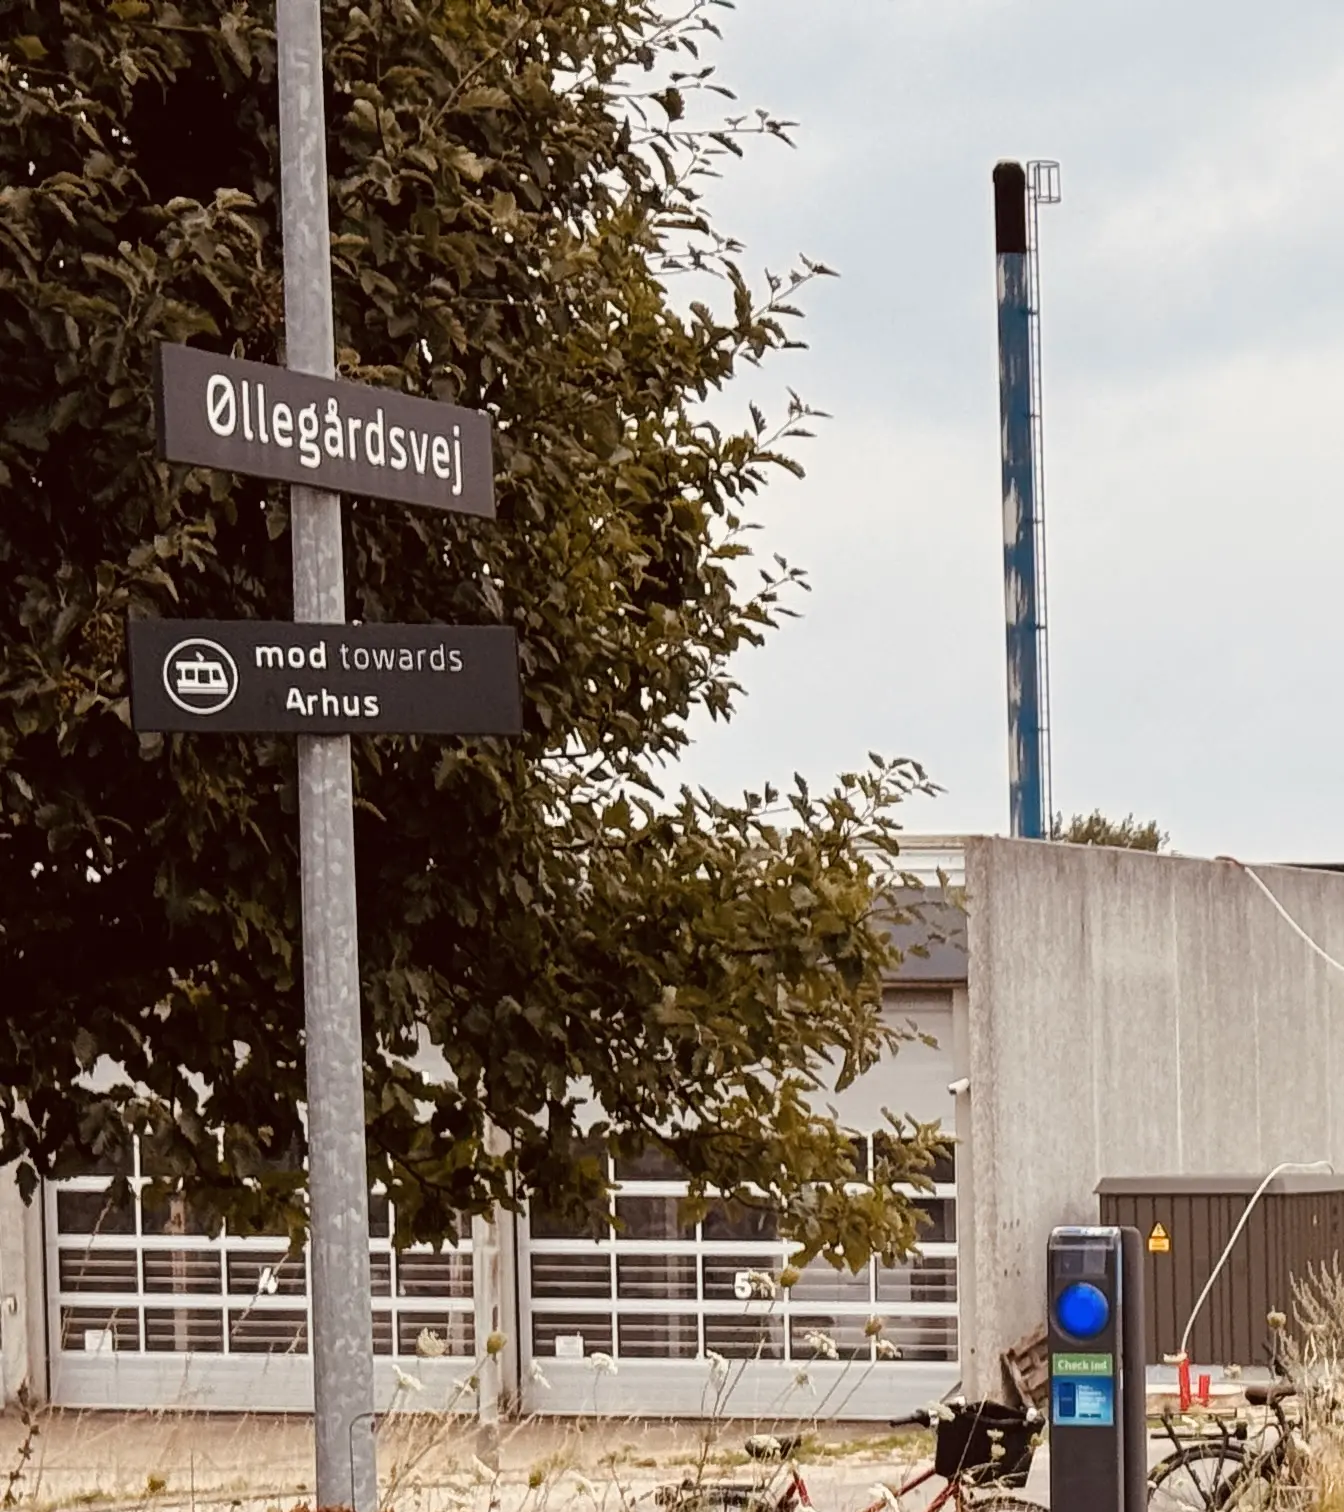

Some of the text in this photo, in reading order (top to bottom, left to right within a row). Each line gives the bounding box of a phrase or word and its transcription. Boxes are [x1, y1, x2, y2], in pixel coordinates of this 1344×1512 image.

[206, 374, 463, 496] Øllegårdsvej
[255, 641, 463, 672] mod towards
[286, 687, 380, 717] Arhus
[734, 1271, 752, 1299] 5
[1058, 1360, 1089, 1371] Check
